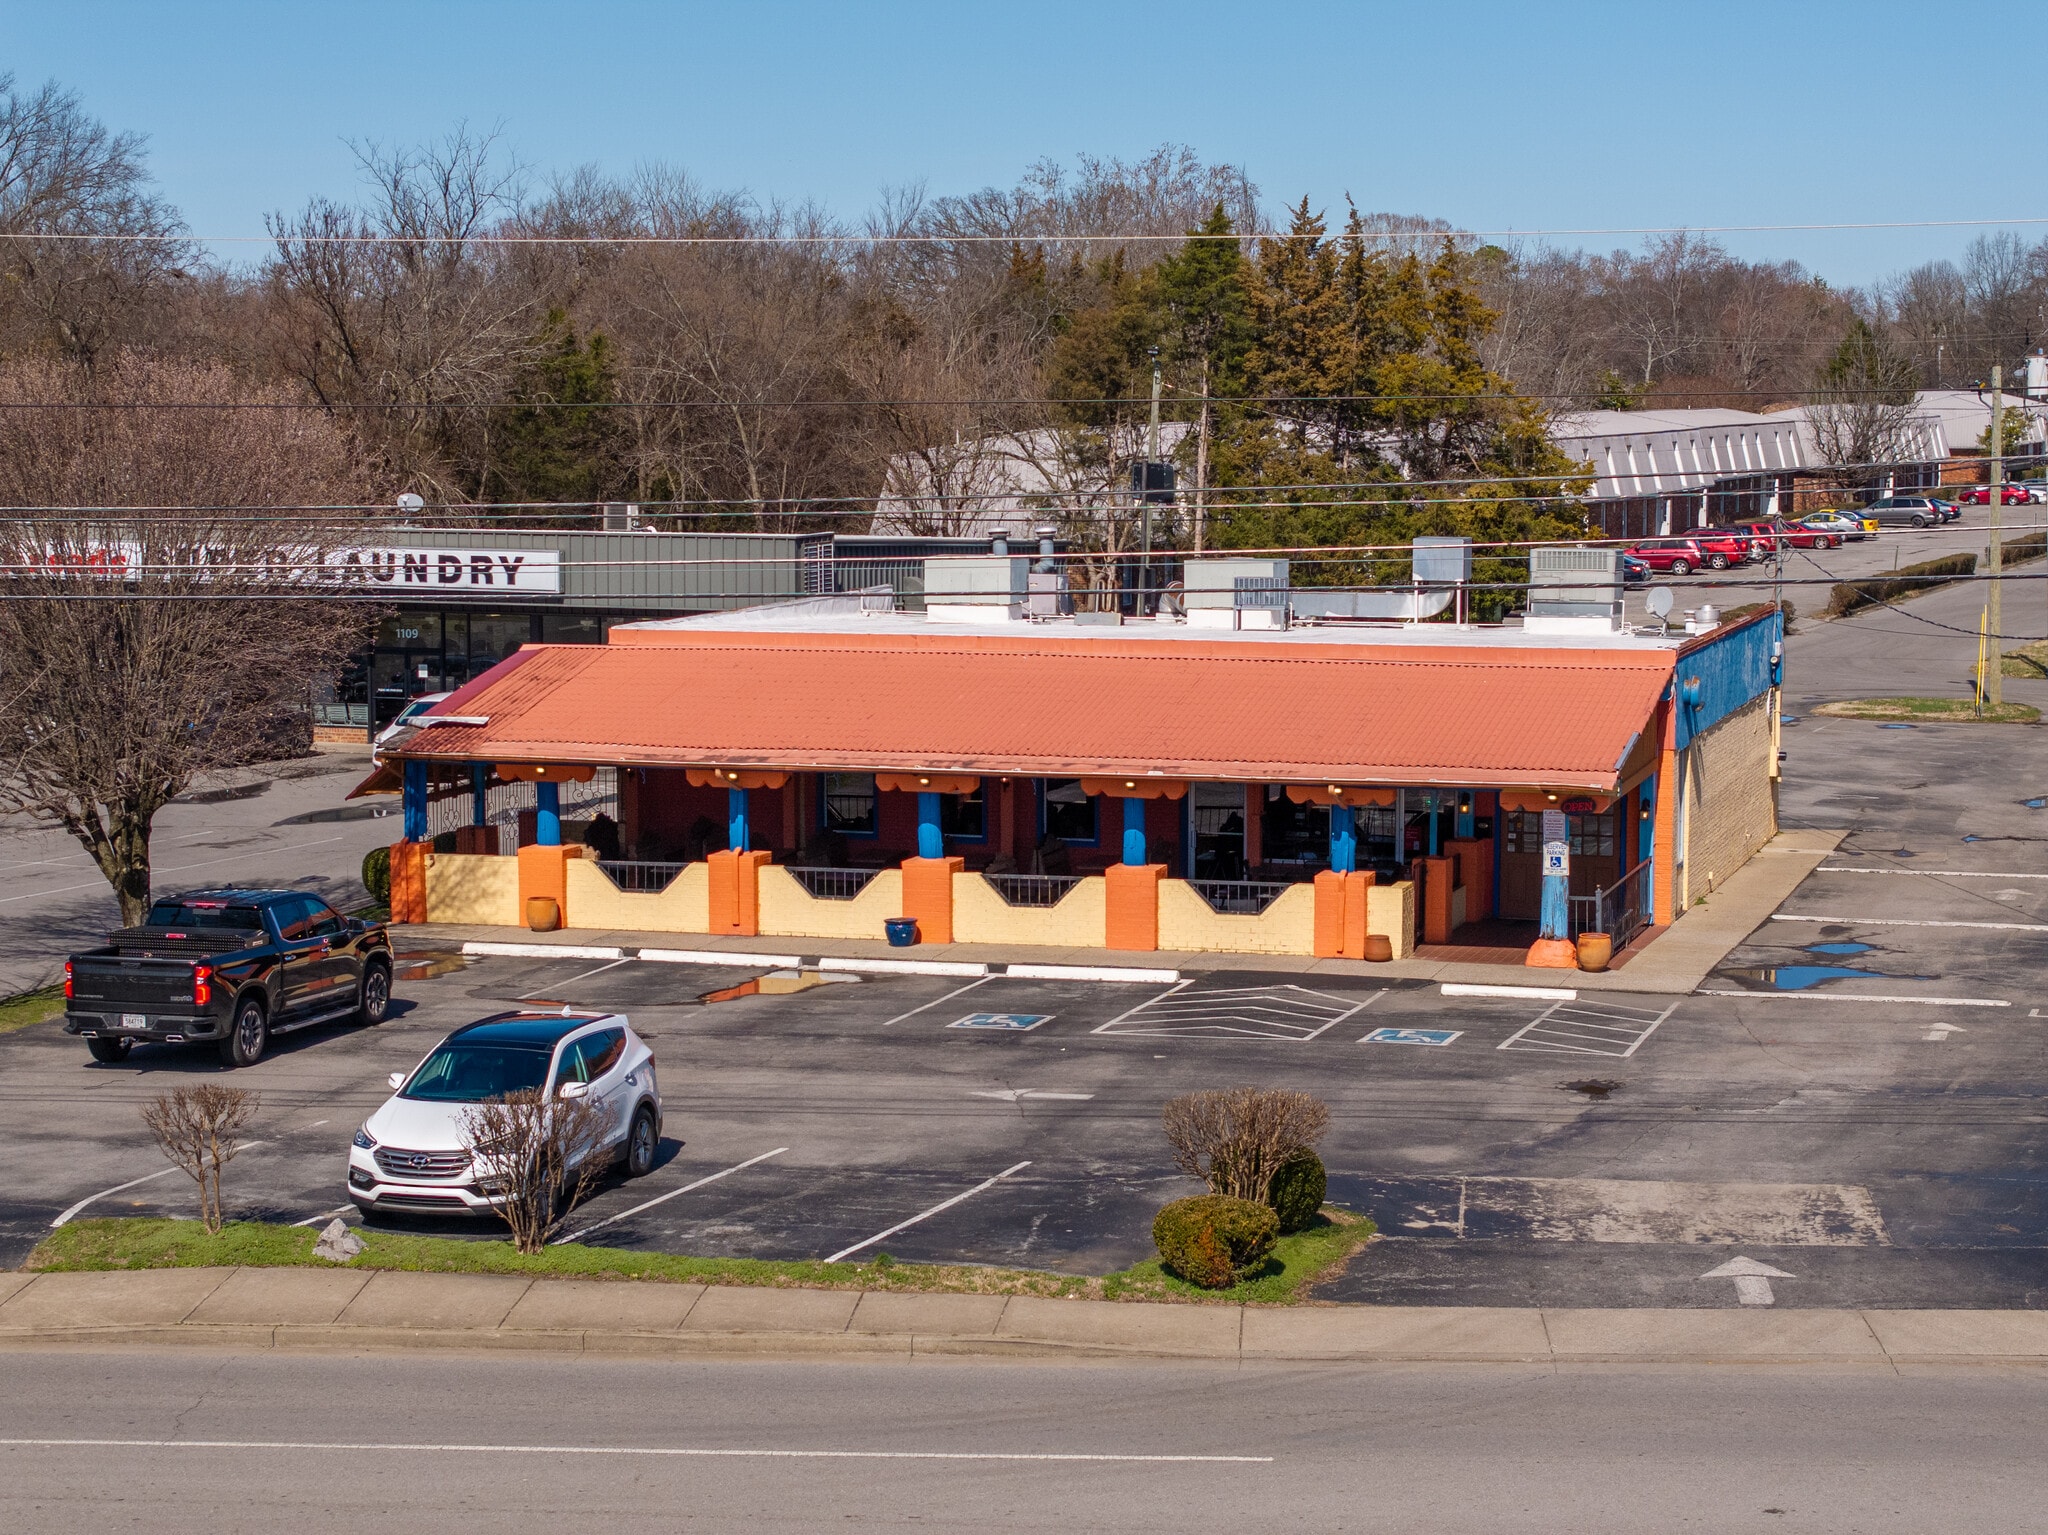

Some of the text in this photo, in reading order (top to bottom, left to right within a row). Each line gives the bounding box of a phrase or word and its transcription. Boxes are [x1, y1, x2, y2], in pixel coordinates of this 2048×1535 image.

[317, 548, 526, 586] LAUNDRY
[396, 628, 419, 639] 1109
[1563, 801, 1593, 812] OPEN
